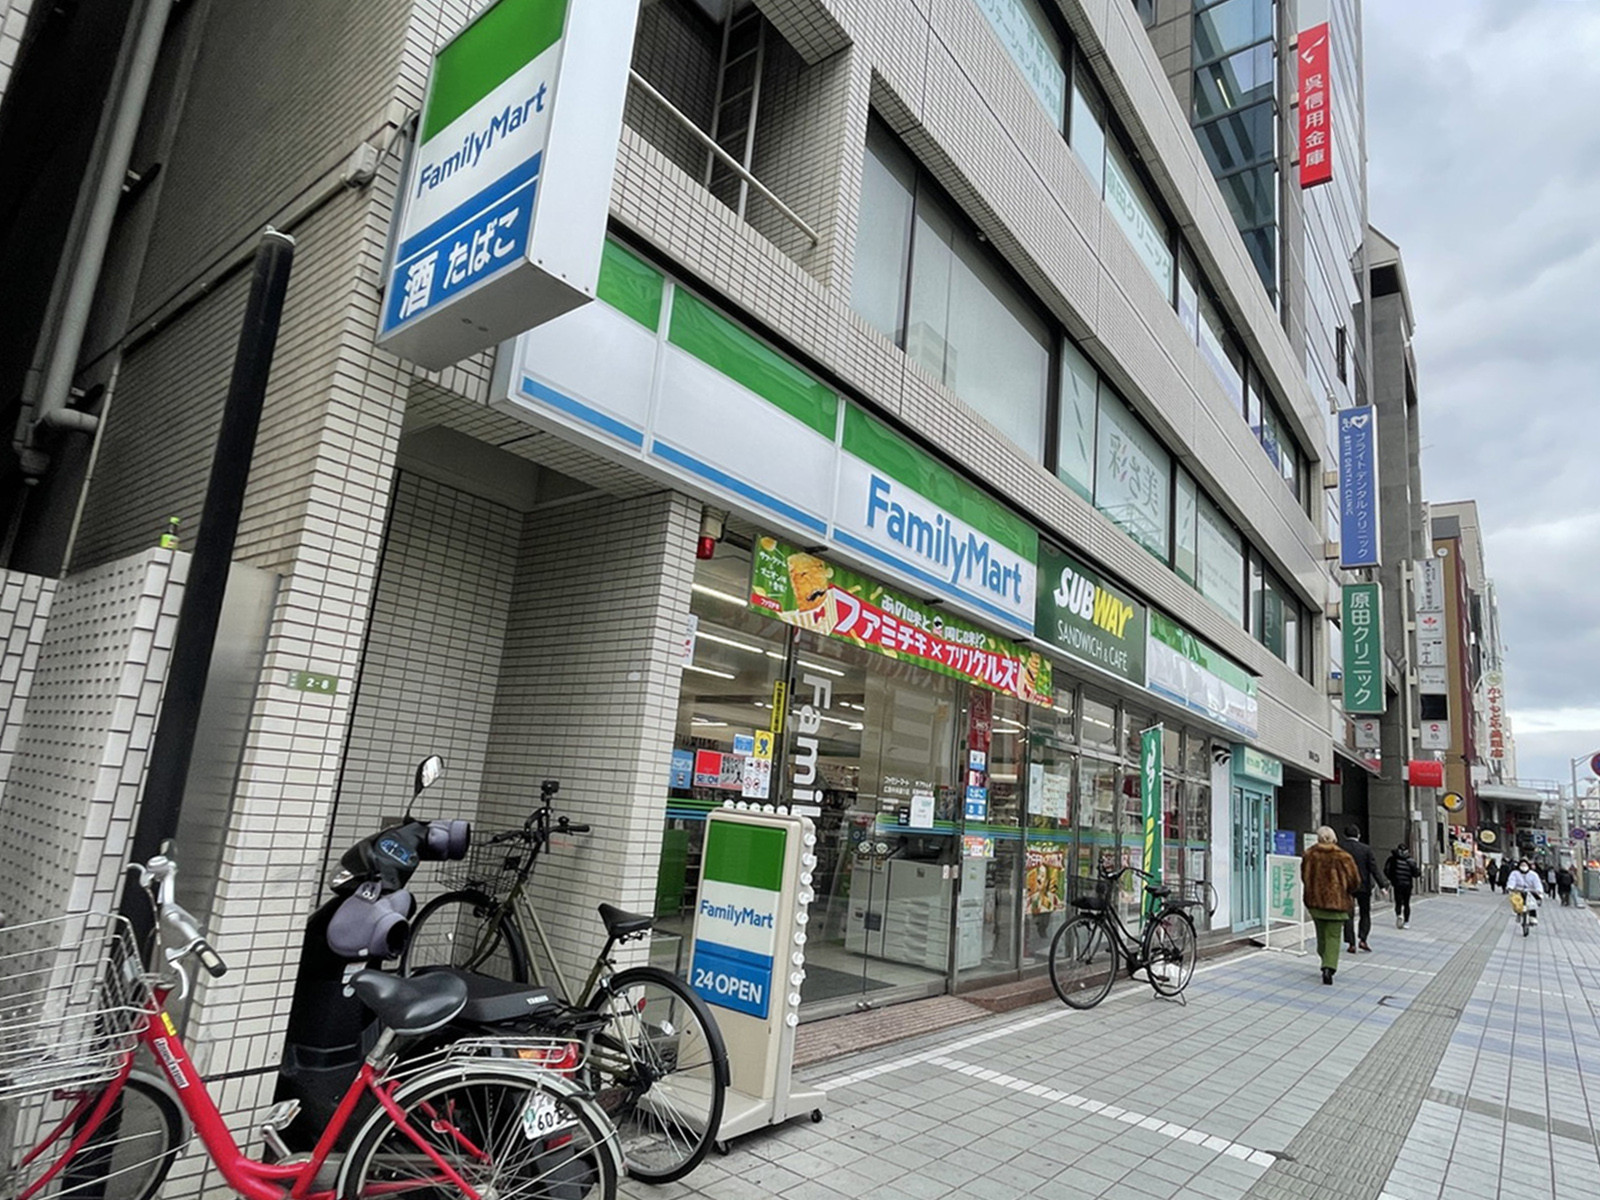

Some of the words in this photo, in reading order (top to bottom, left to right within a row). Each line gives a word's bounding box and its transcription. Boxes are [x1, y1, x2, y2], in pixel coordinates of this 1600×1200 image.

[417, 81, 547, 199] FamilyMart
[1305, 74, 1325, 167] 呉信用金庫
[399, 250, 439, 320] 酒
[443, 207, 520, 289] たばこ
[866, 473, 1022, 604] FamilyMart
[1053, 567, 1134, 639] SUBWAY
[1057, 619, 1103, 659] SANDWICH
[1350, 591, 1372, 705] 原田クリニック
[700, 899, 774, 929] FamilyMart
